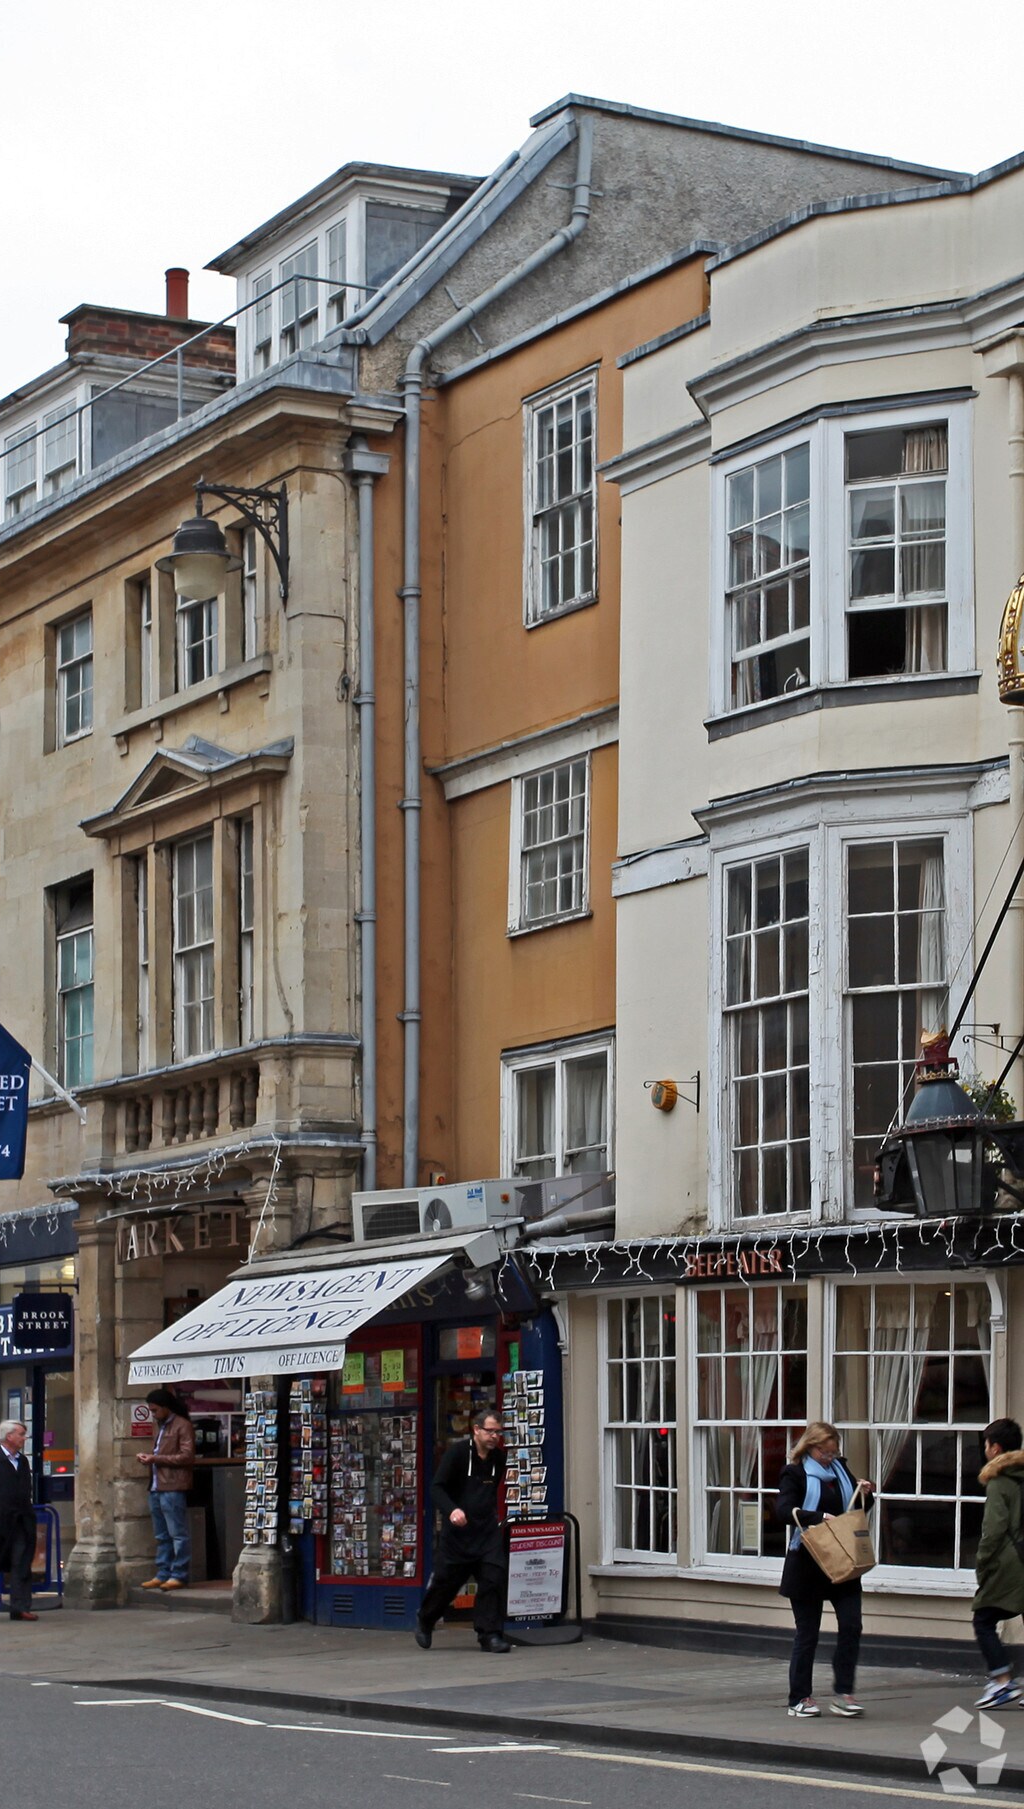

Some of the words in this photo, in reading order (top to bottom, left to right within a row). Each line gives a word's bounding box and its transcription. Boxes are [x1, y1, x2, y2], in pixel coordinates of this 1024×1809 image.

[686, 1249, 783, 1277] BEEFEATER
[218, 1267, 424, 1308] NEWSAGENT
[22, 1311, 65, 1320] BROOK
[17, 1321, 69, 1330] STREET
[173, 1315, 236, 1343] OFF
[227, 1306, 372, 1337] LICENCE
[213, 1356, 246, 1375] TIM'S
[278, 1353, 297, 1367] OFF
[297, 1350, 340, 1365] LICENCE
[132, 1362, 185, 1377] NEWSAGENT
[510, 1542, 534, 1551] STUDENT
[536, 1538, 561, 1548] DISCOUNT
